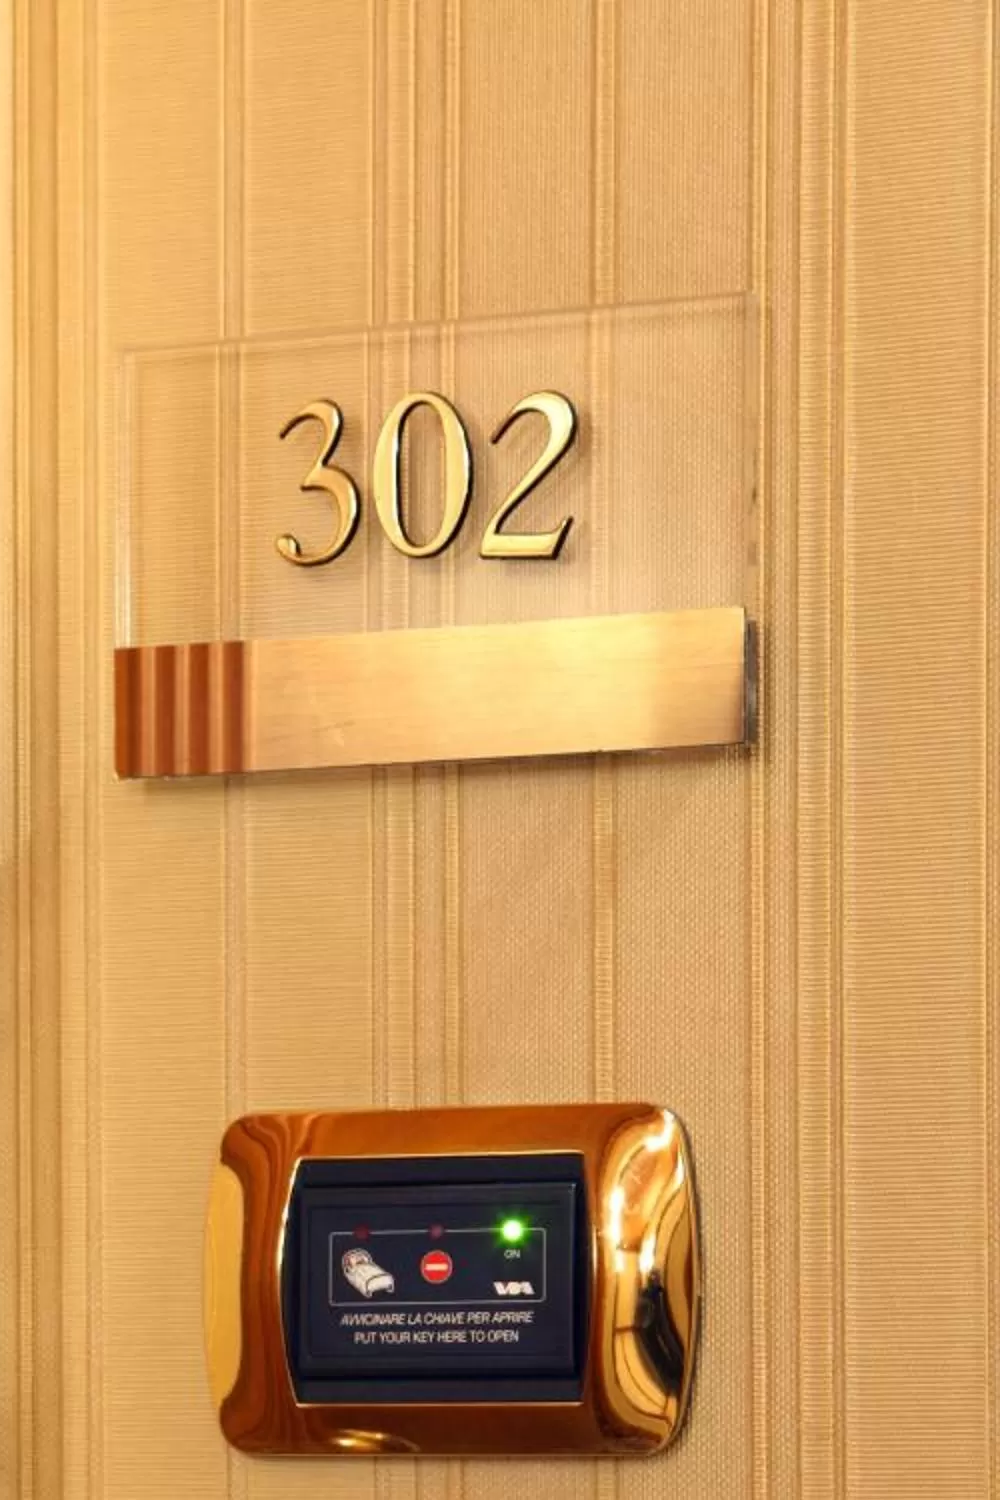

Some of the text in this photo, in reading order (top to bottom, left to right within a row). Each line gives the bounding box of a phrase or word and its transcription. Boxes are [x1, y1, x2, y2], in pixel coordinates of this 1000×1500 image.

[274, 389, 578, 567] 302
[503, 1249, 521, 1259] ON
[407, 1311, 422, 1325] LA
[423, 1311, 465, 1325] CHIAVE
[467, 1311, 491, 1324] PER
[491, 1310, 535, 1324] APRIRE
[354, 1329, 520, 1344] PUT YOUR KEY HERE TO OPEN
